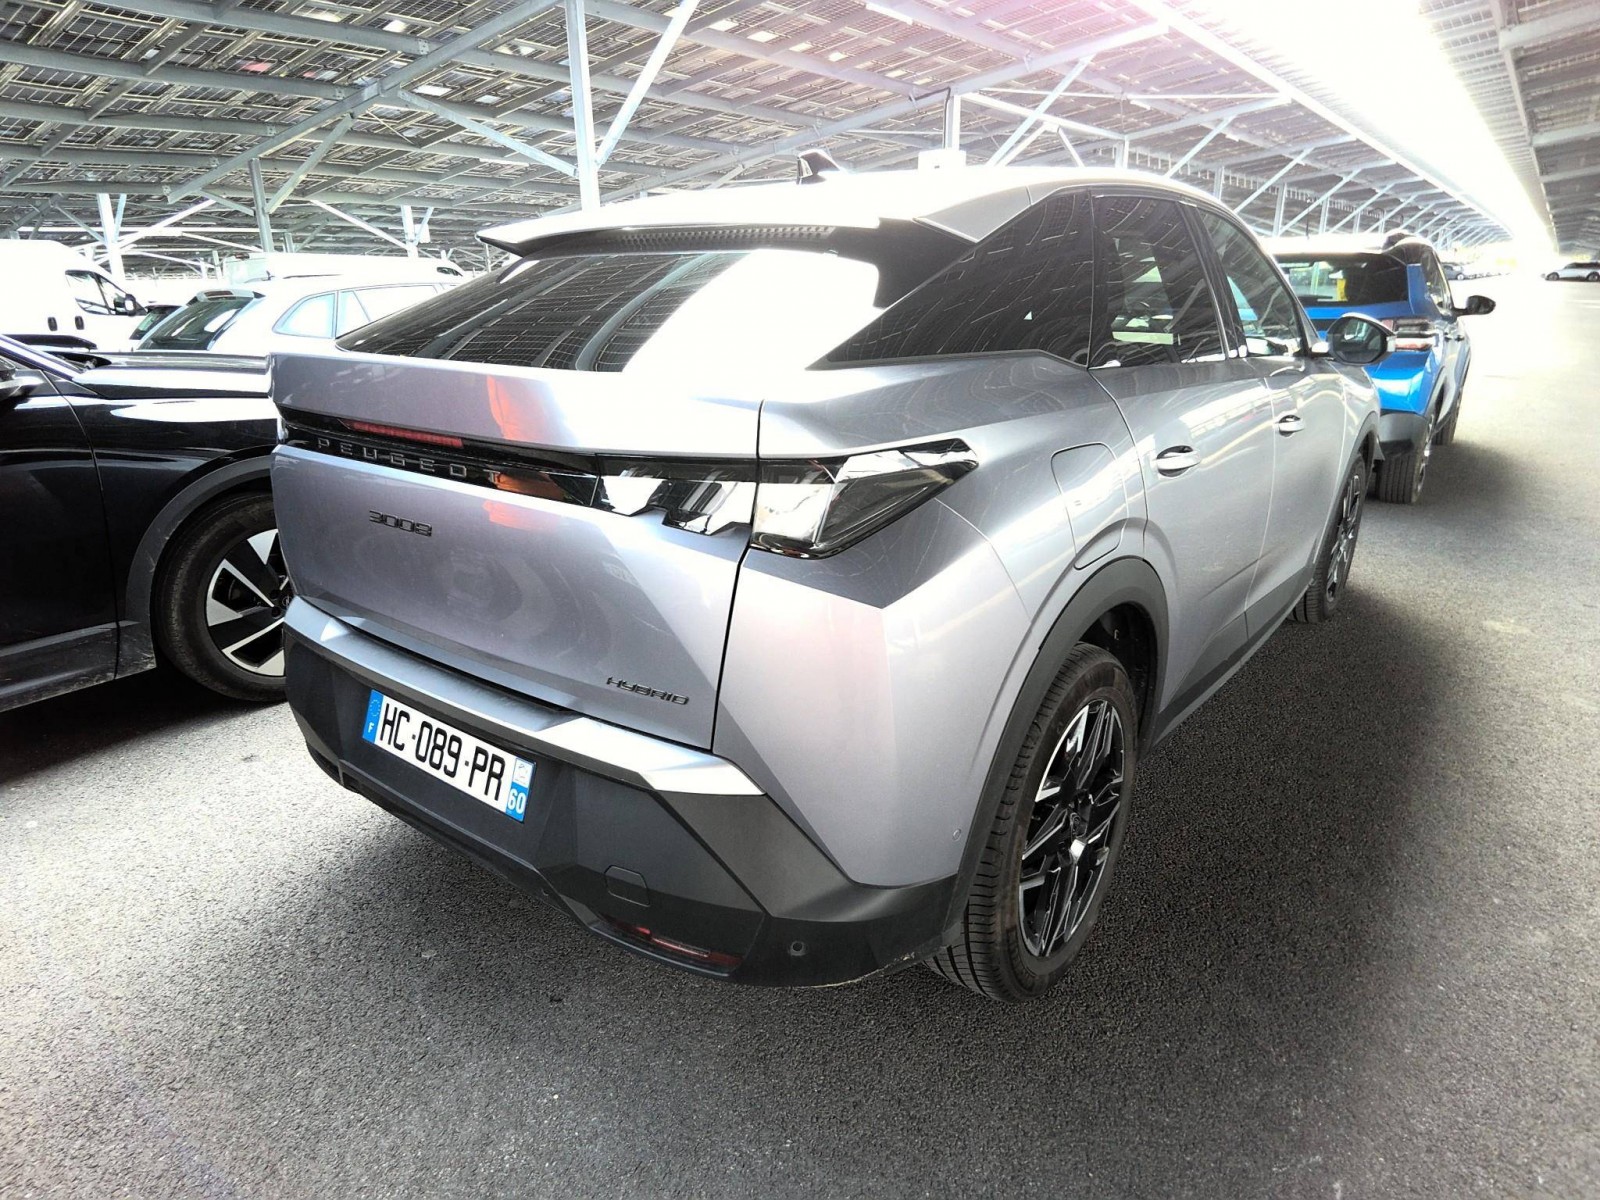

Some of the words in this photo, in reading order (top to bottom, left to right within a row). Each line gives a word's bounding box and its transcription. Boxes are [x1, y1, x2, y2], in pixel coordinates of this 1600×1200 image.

[317, 437, 501, 484] PEUGEOT
[369, 510, 432, 537] 3008
[606, 676, 690, 706] HYBRID
[507, 788, 527, 814] 60
